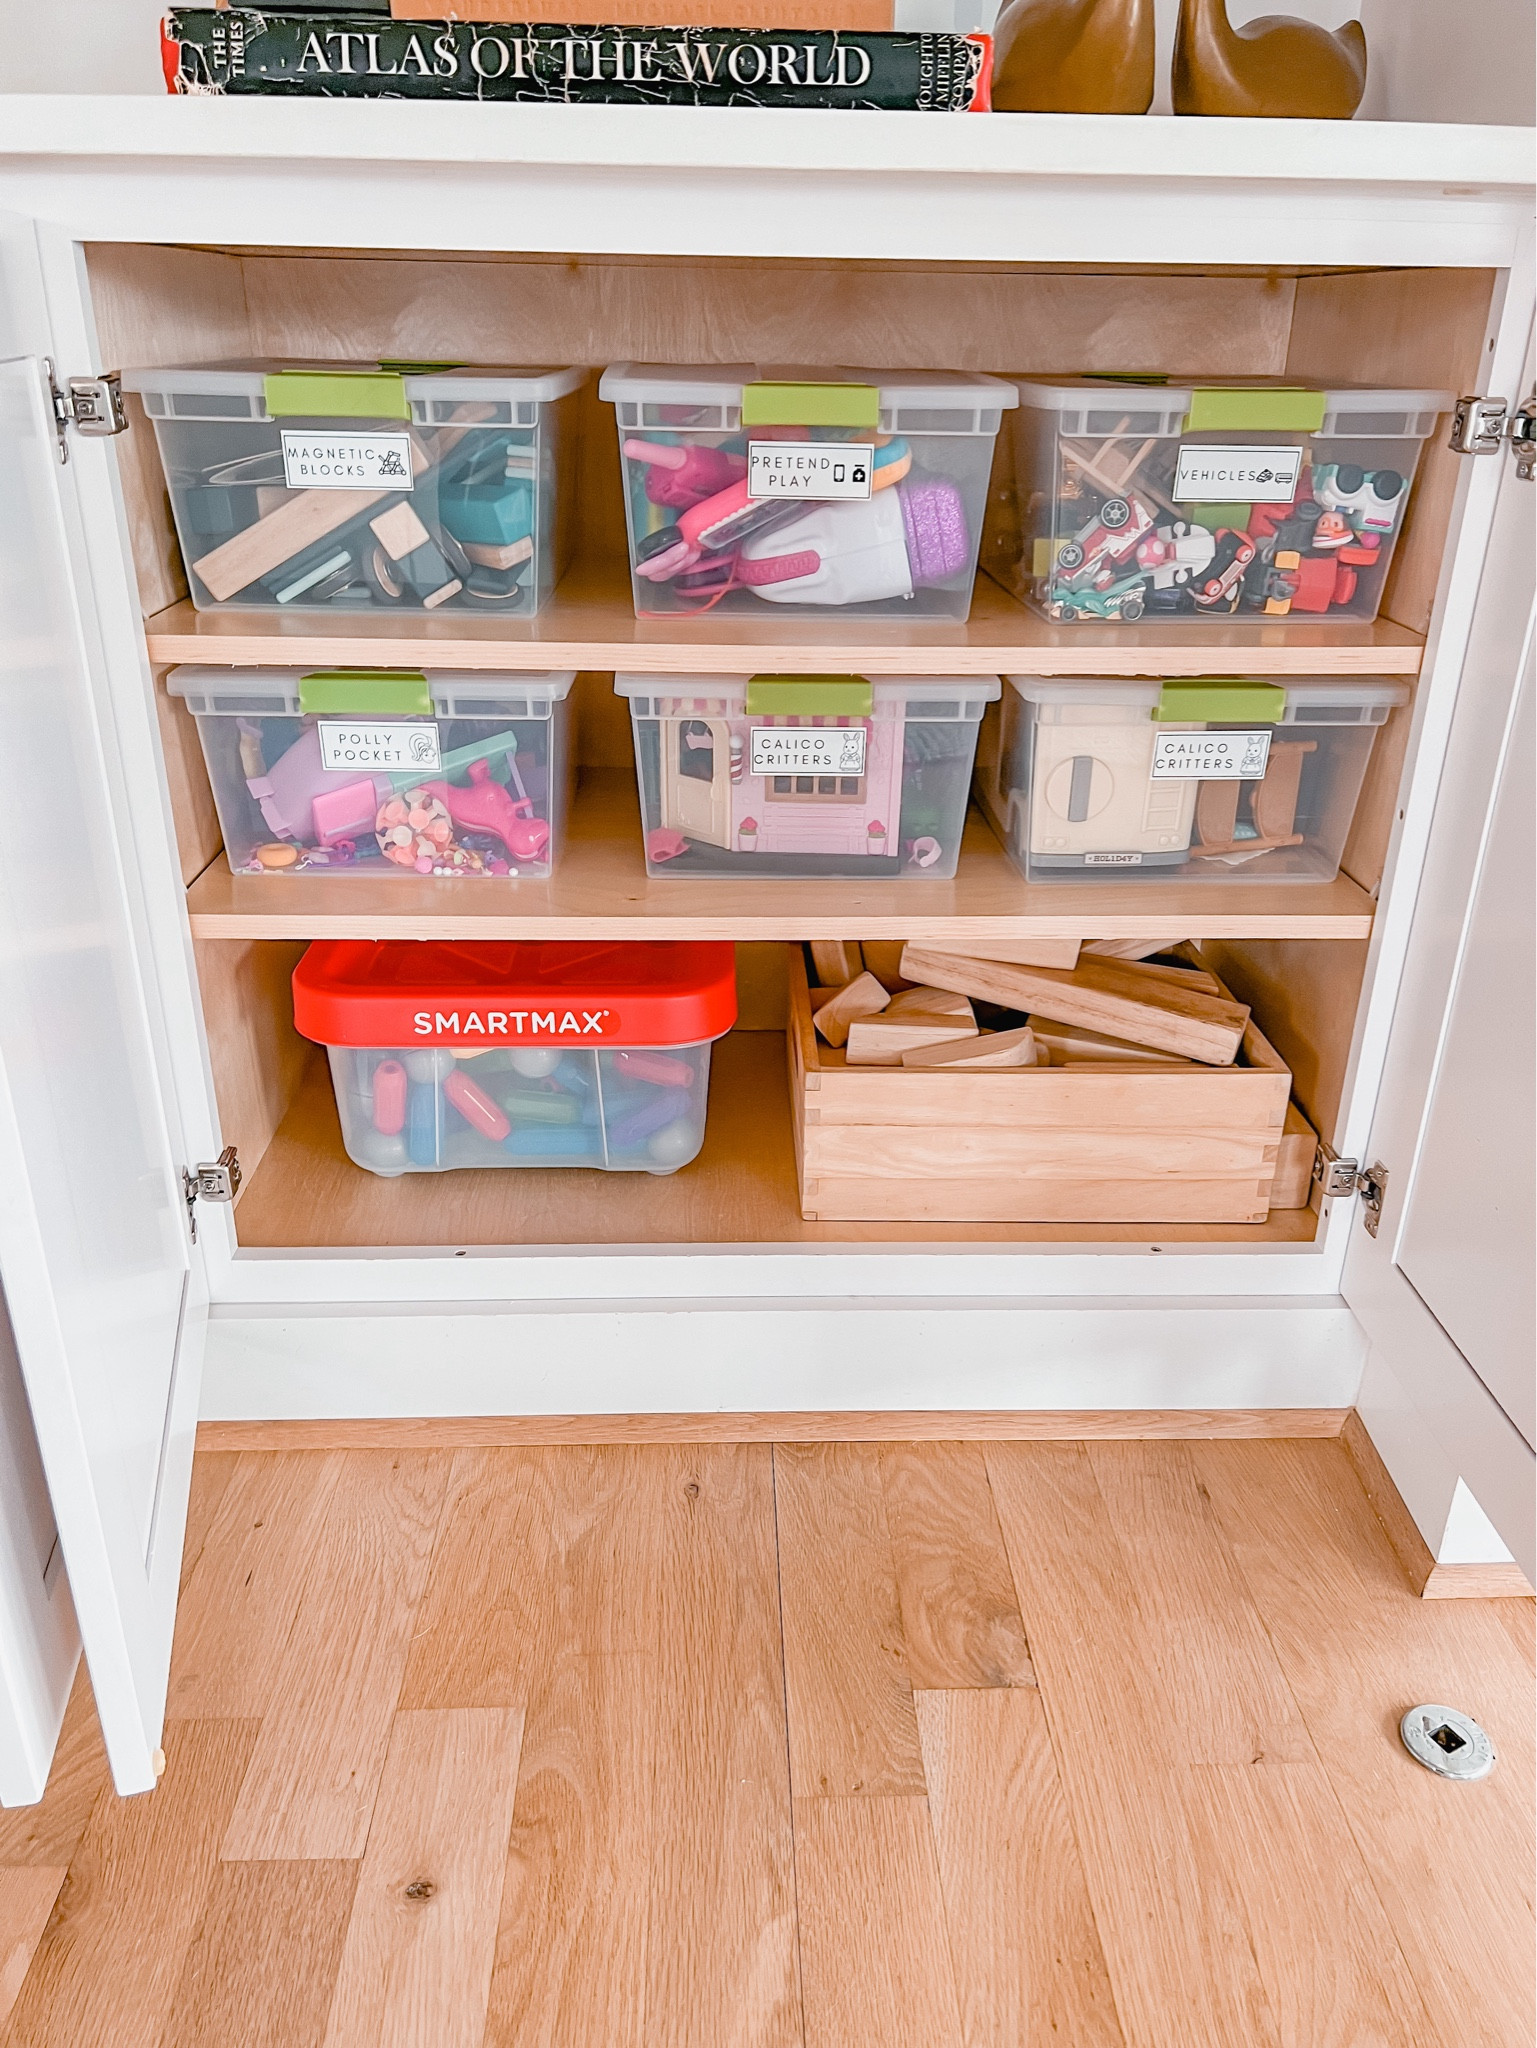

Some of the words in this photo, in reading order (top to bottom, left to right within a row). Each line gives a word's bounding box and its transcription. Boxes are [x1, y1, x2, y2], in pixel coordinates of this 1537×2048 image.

[212, 27, 227, 69] THE
[230, 21, 246, 78] TIMES
[296, 32, 459, 78] ATLAS
[470, 35, 535, 80] OF
[550, 38, 665, 82] THE
[666, 42, 872, 86] WORLD
[287, 447, 375, 460] MAGNETIC
[752, 456, 831, 470] PRETEND
[300, 464, 365, 476] BLOCKS
[1180, 469, 1256, 481] VEHICLES
[769, 475, 812, 487] PLAY
[339, 733, 392, 745] POLLY
[761, 738, 825, 750] CALICO
[1164, 743, 1228, 754] CALICO
[333, 749, 401, 761] POCKET
[754, 754, 832, 765] CRITTERS
[1155, 758, 1234, 769] CRITTERS
